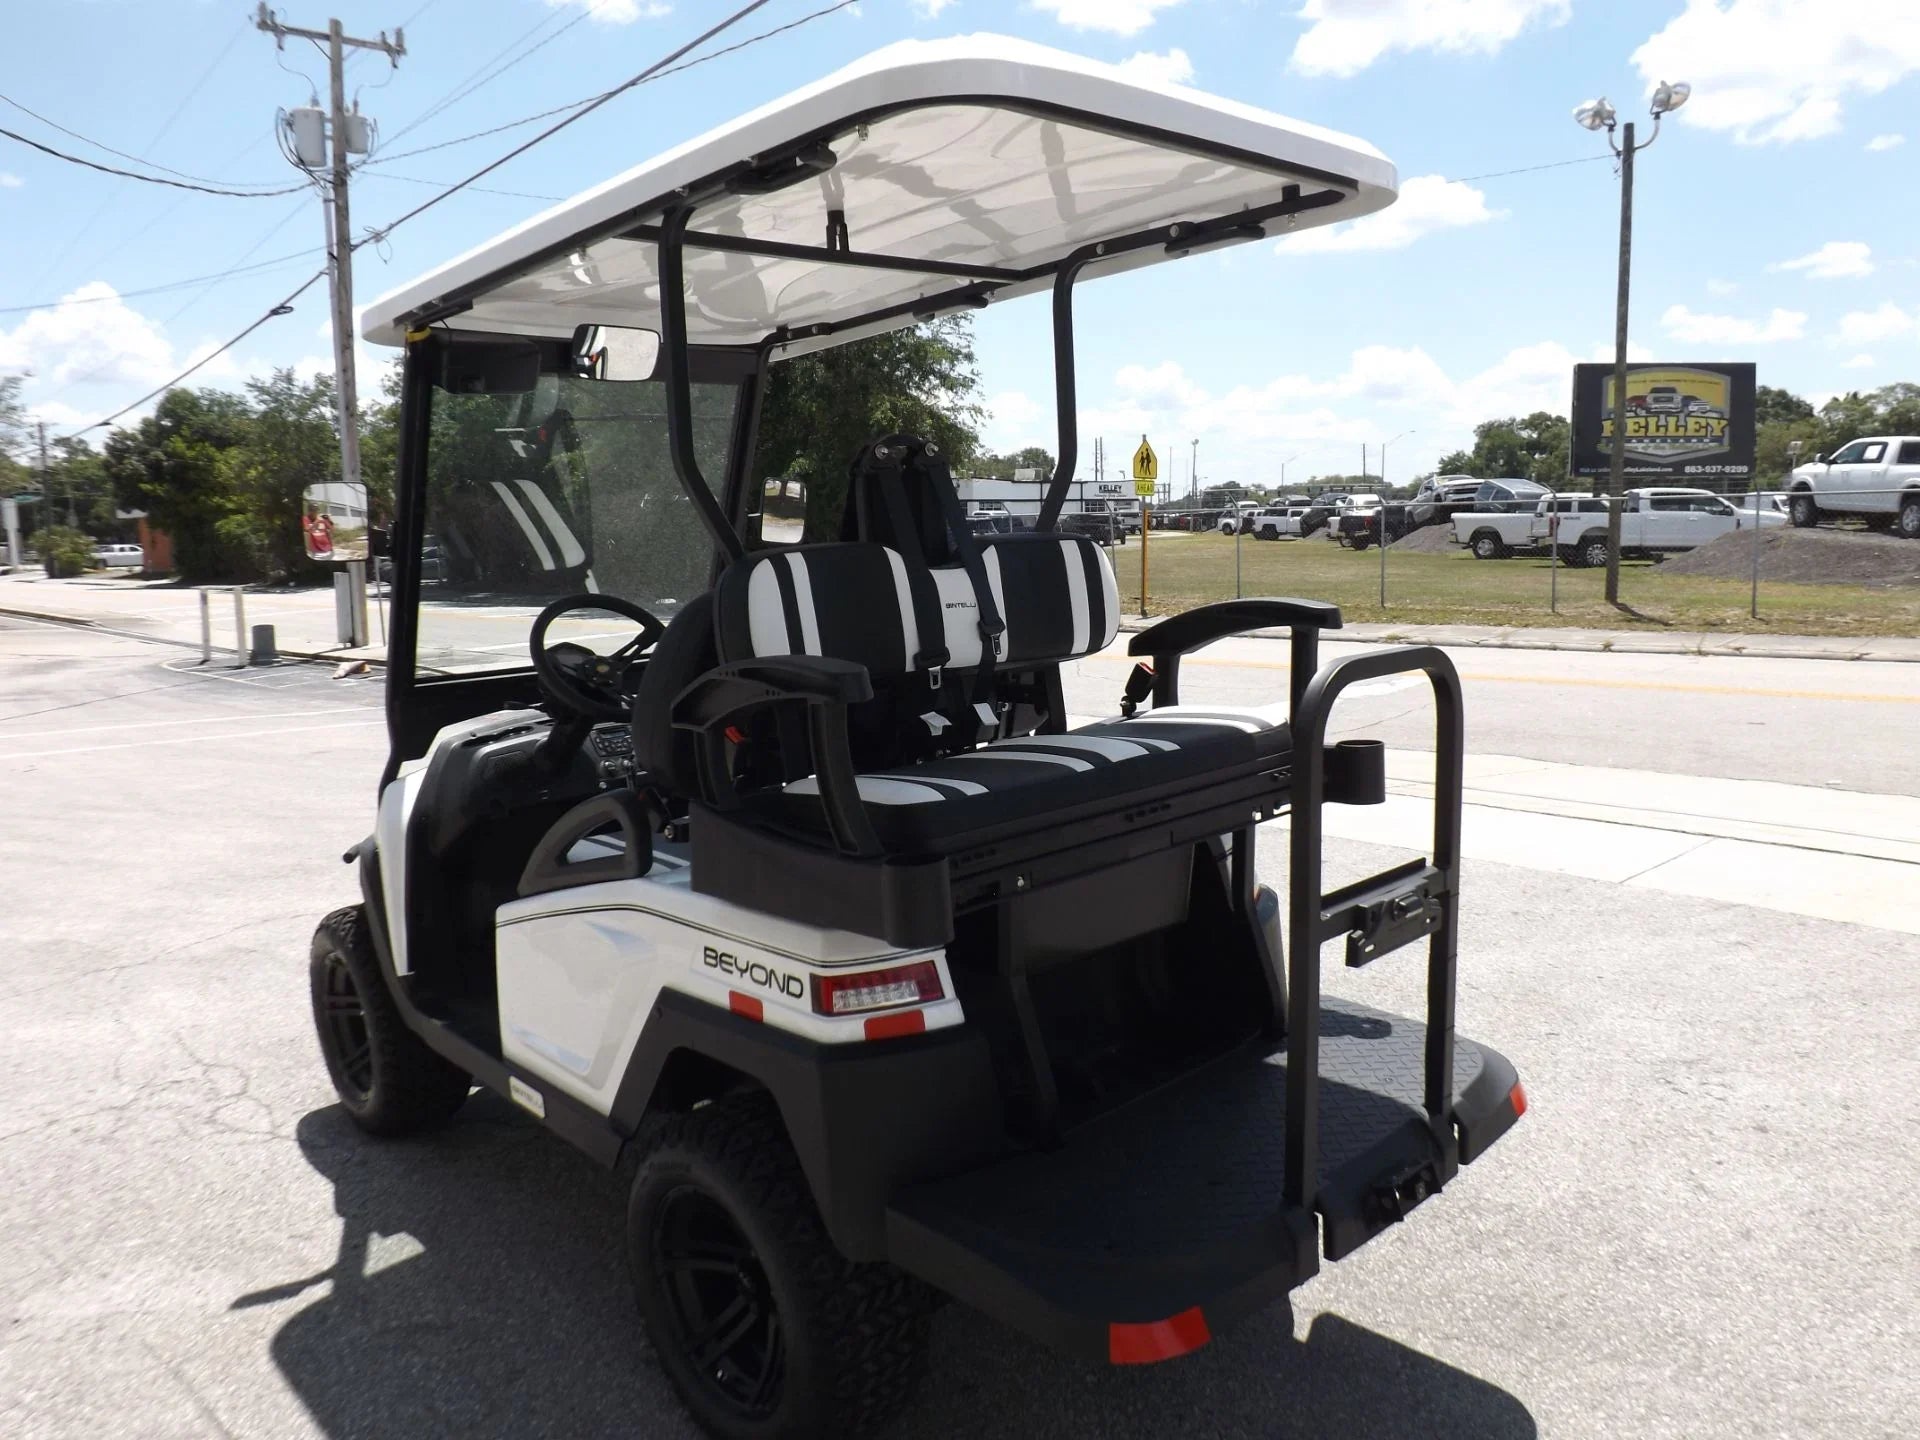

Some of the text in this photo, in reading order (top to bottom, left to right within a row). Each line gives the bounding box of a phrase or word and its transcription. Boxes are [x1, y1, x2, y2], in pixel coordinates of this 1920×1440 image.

[1099, 484, 1122, 493] KELLEY
[1137, 483, 1154, 493] AHEAD
[703, 945, 804, 999] BEYOND
